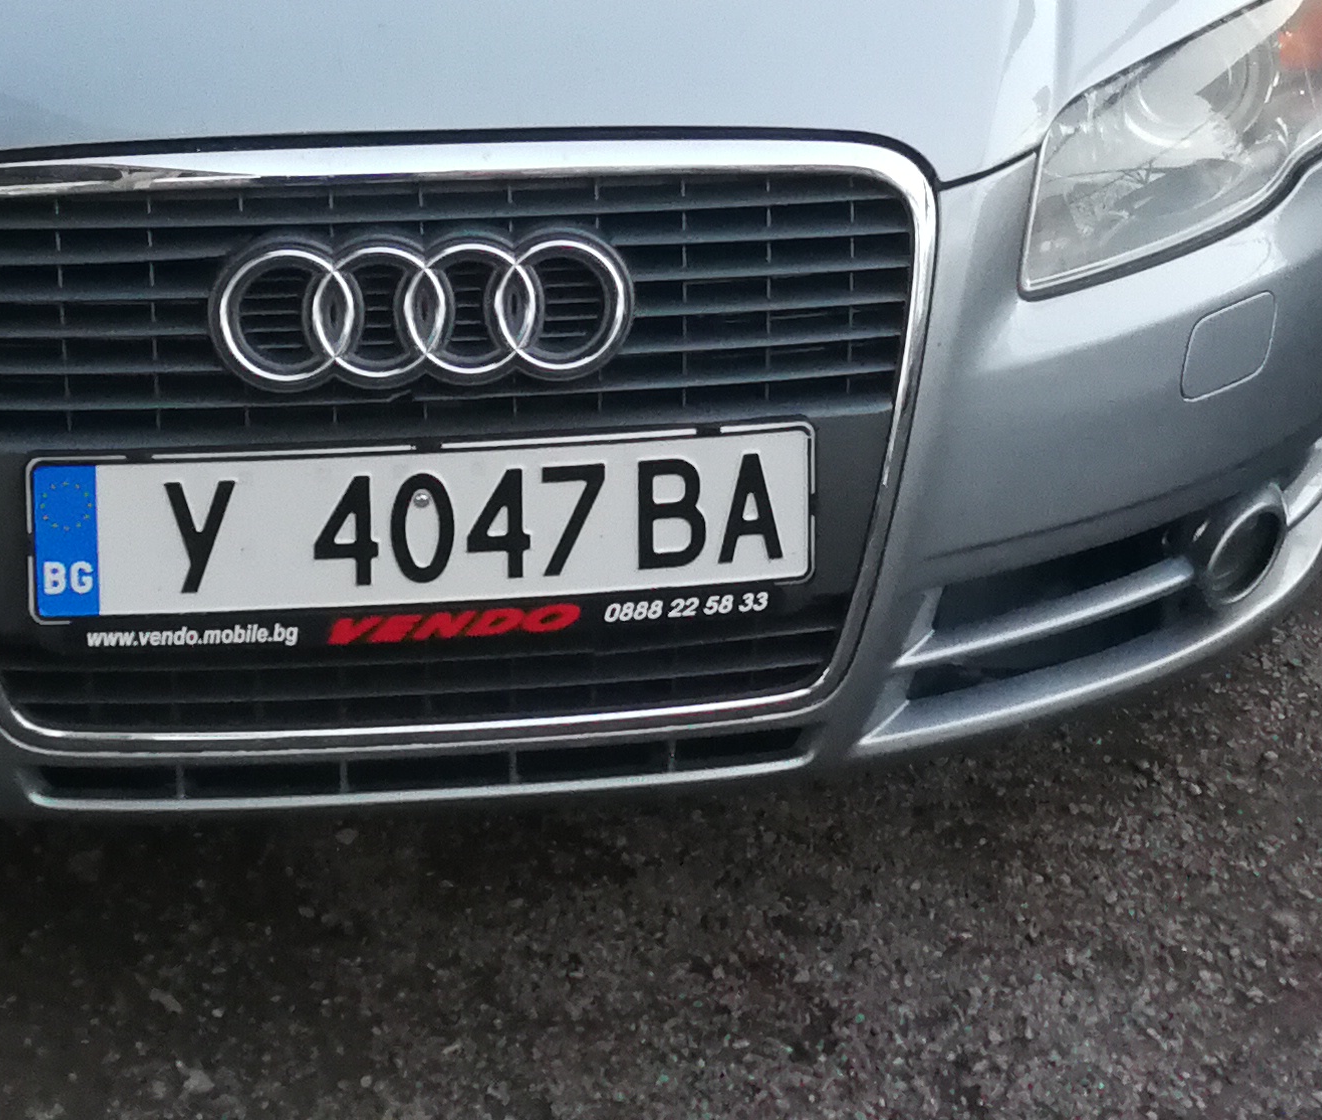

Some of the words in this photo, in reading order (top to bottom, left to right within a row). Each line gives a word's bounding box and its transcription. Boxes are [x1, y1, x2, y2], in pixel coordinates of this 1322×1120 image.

[313, 462, 606, 586] 4047
[42, 560, 94, 595] BG
[86, 623, 299, 647] www.vendo.mobile.bg
[327, 603, 582, 645] VENDO
[603, 599, 664, 623] 0888
[667, 597, 699, 618] 22
[703, 594, 734, 615] 58
[738, 591, 769, 612] 33
